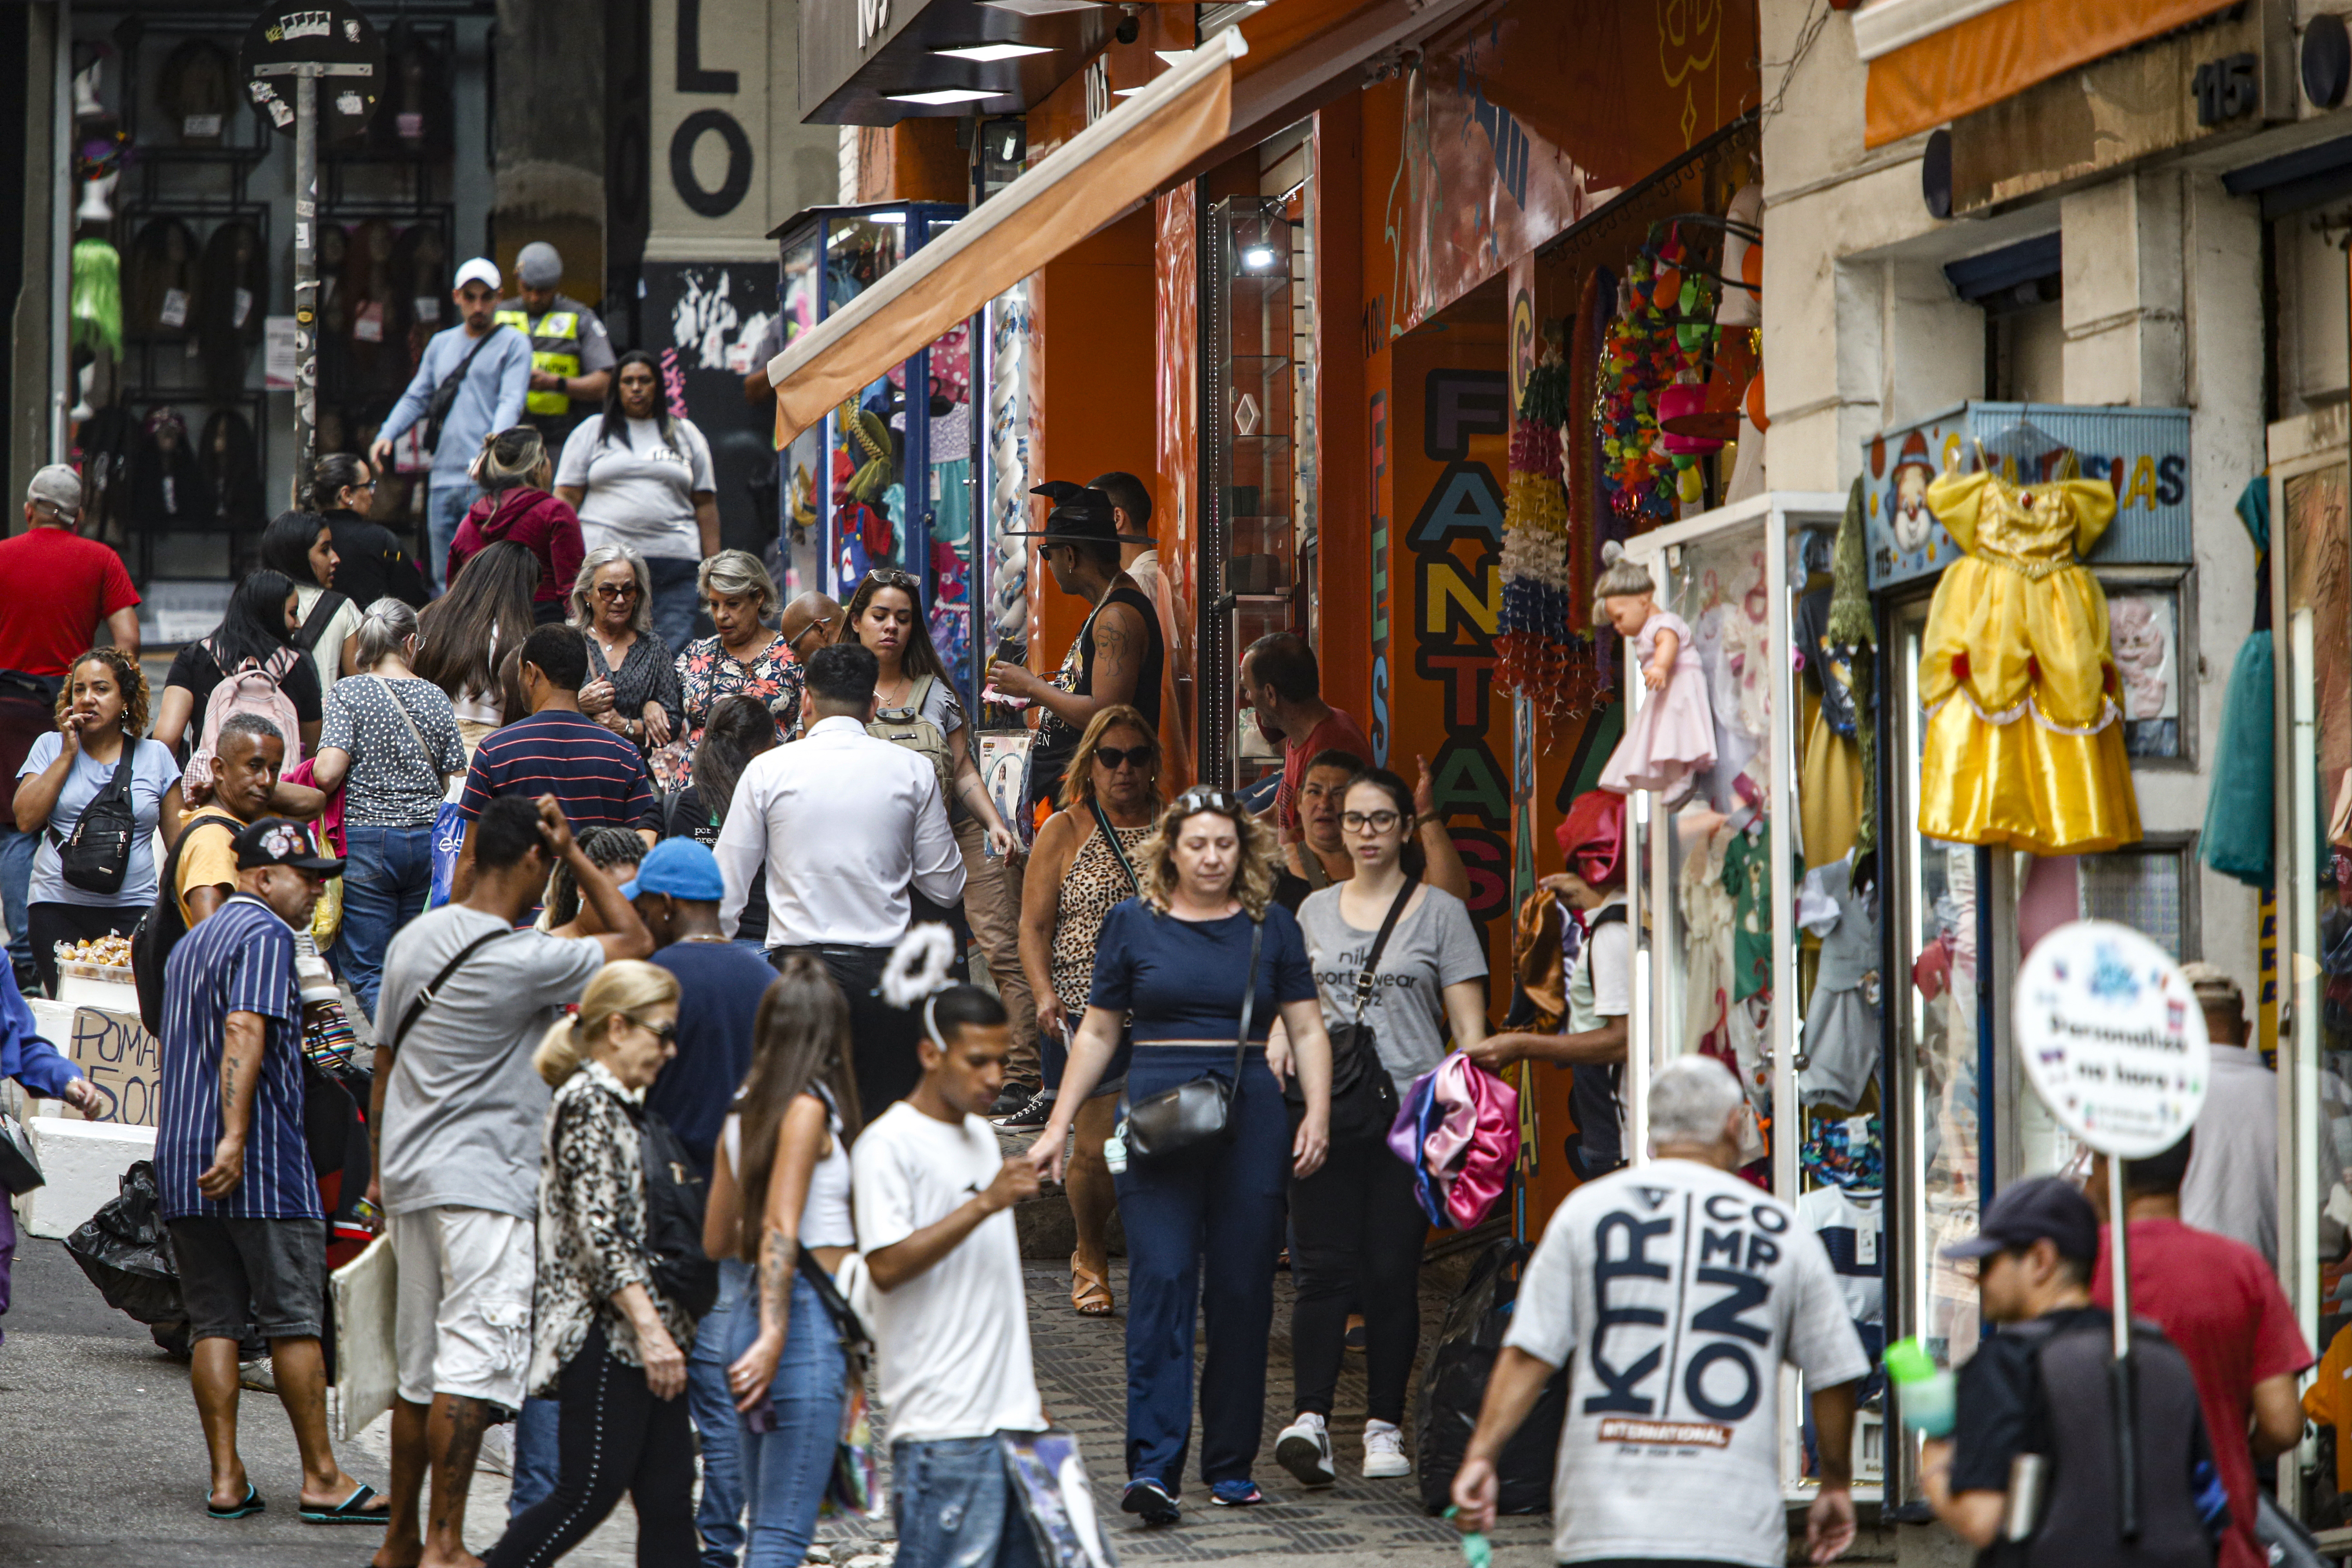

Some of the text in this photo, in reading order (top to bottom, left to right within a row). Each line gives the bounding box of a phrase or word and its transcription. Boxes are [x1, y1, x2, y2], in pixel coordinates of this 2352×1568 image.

[2192, 53, 2256, 127] 115
[1363, 293, 1385, 358] 109
[694, 828, 711, 836] por
[1339, 947, 1382, 967] nik
[72, 1006, 160, 1072] POMA
